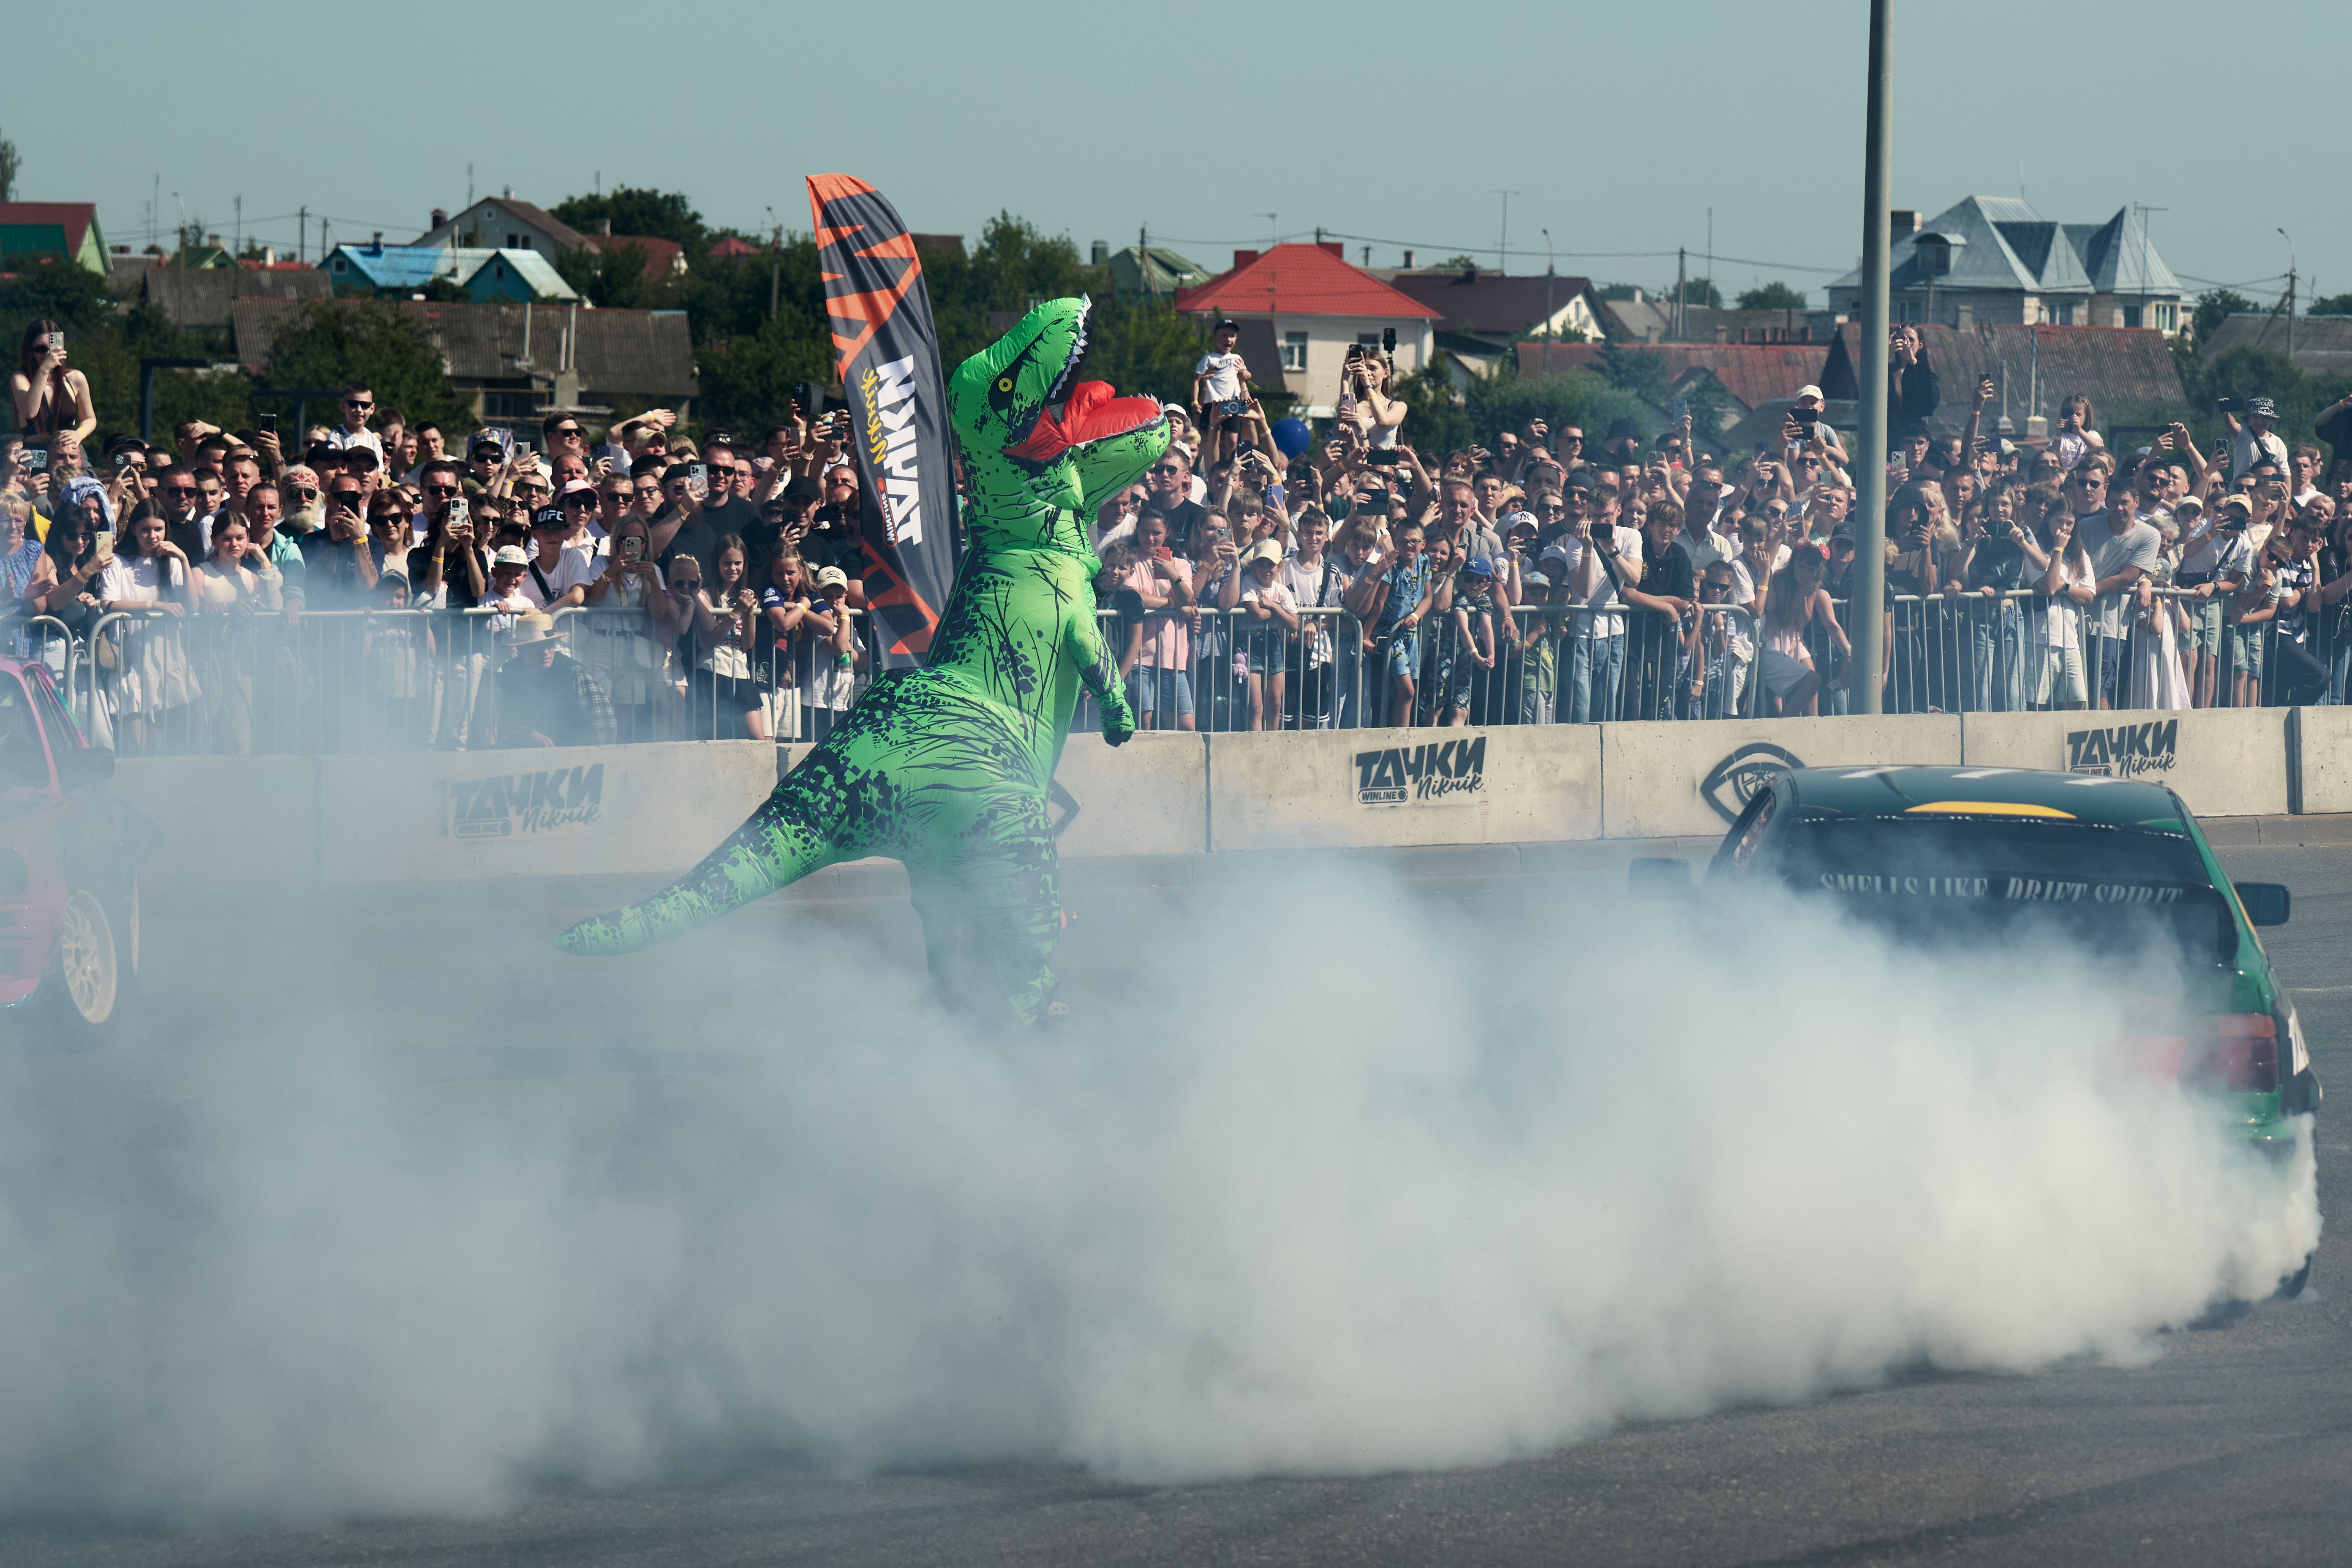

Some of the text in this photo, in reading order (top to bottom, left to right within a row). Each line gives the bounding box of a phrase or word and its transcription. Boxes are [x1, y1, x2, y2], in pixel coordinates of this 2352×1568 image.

[538, 510, 564, 523] UFC
[2067, 719, 2178, 765] ТАЧКИ
[1356, 736, 1486, 789] ТАЧКИ
[1362, 791, 1396, 801] WINLINE
